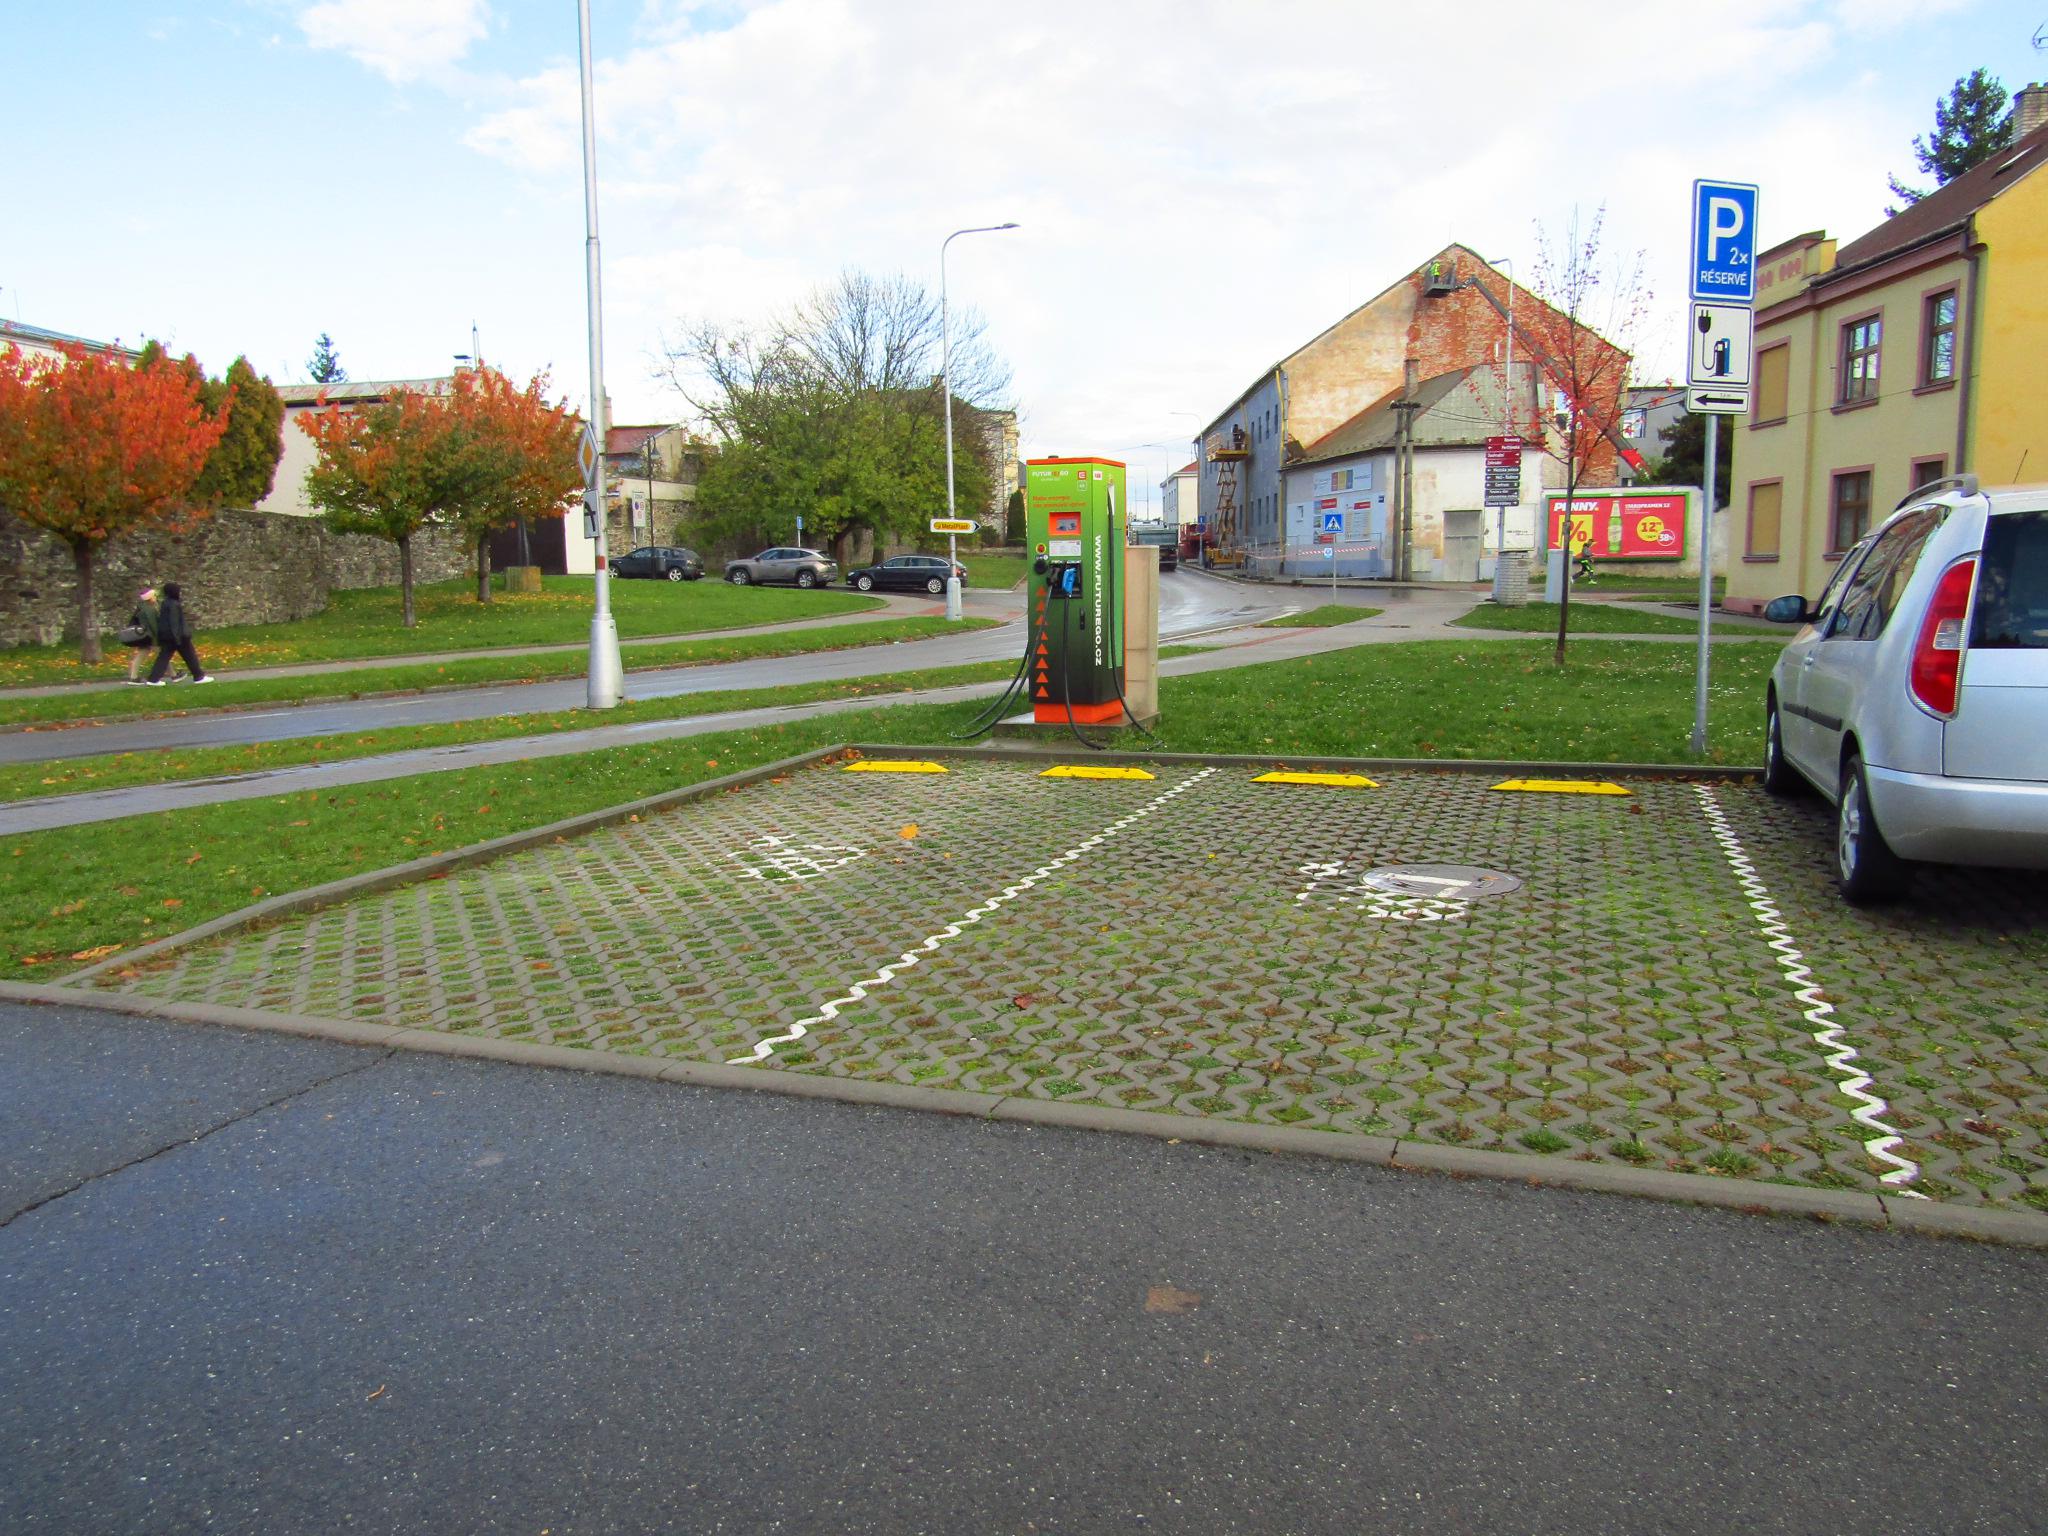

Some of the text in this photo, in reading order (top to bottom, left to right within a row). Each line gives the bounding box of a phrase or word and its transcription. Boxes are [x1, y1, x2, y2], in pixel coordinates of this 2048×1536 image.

[1708, 197, 1744, 262] P
[1729, 247, 1749, 266] 2x
[1700, 269, 1748, 287] RÉSERVÉ
